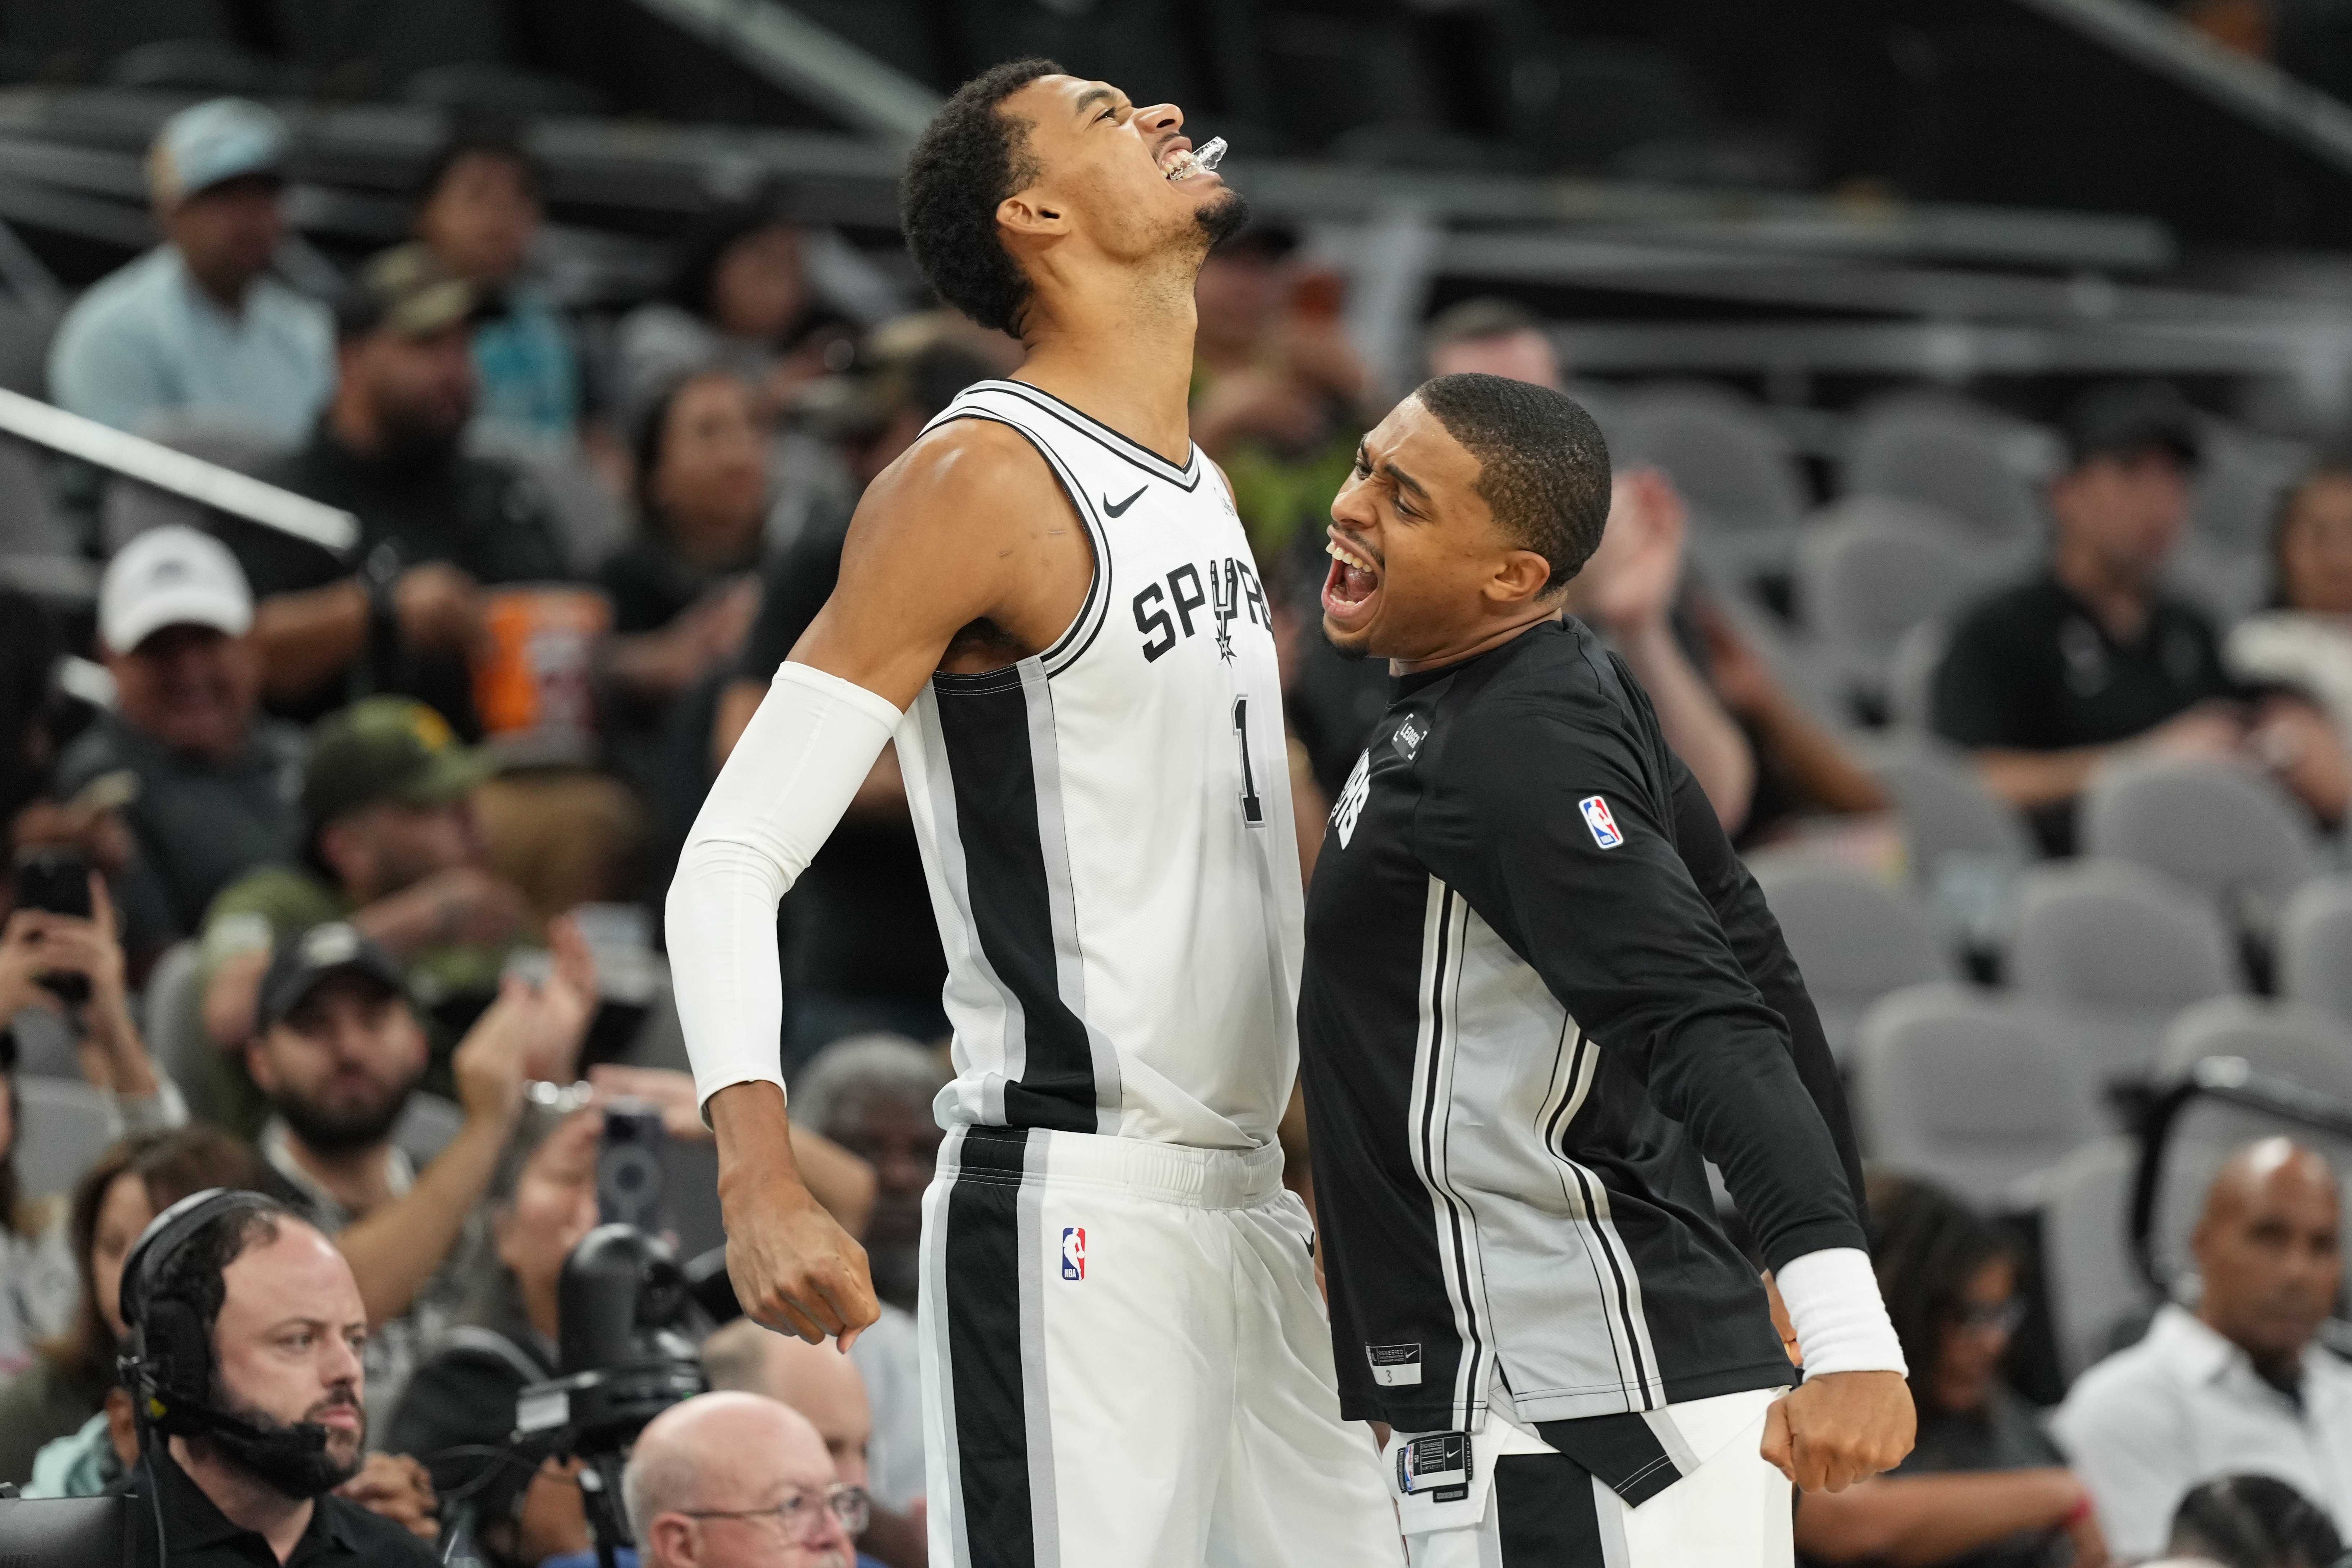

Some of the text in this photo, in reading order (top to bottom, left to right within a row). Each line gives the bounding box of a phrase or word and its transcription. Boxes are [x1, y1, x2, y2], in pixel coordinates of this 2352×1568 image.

[1400, 723, 1420, 748] LEDGER
[1231, 693, 1266, 827] 1
[1064, 1268, 1076, 1278] NBA
[1386, 1370, 1392, 1383] 3
